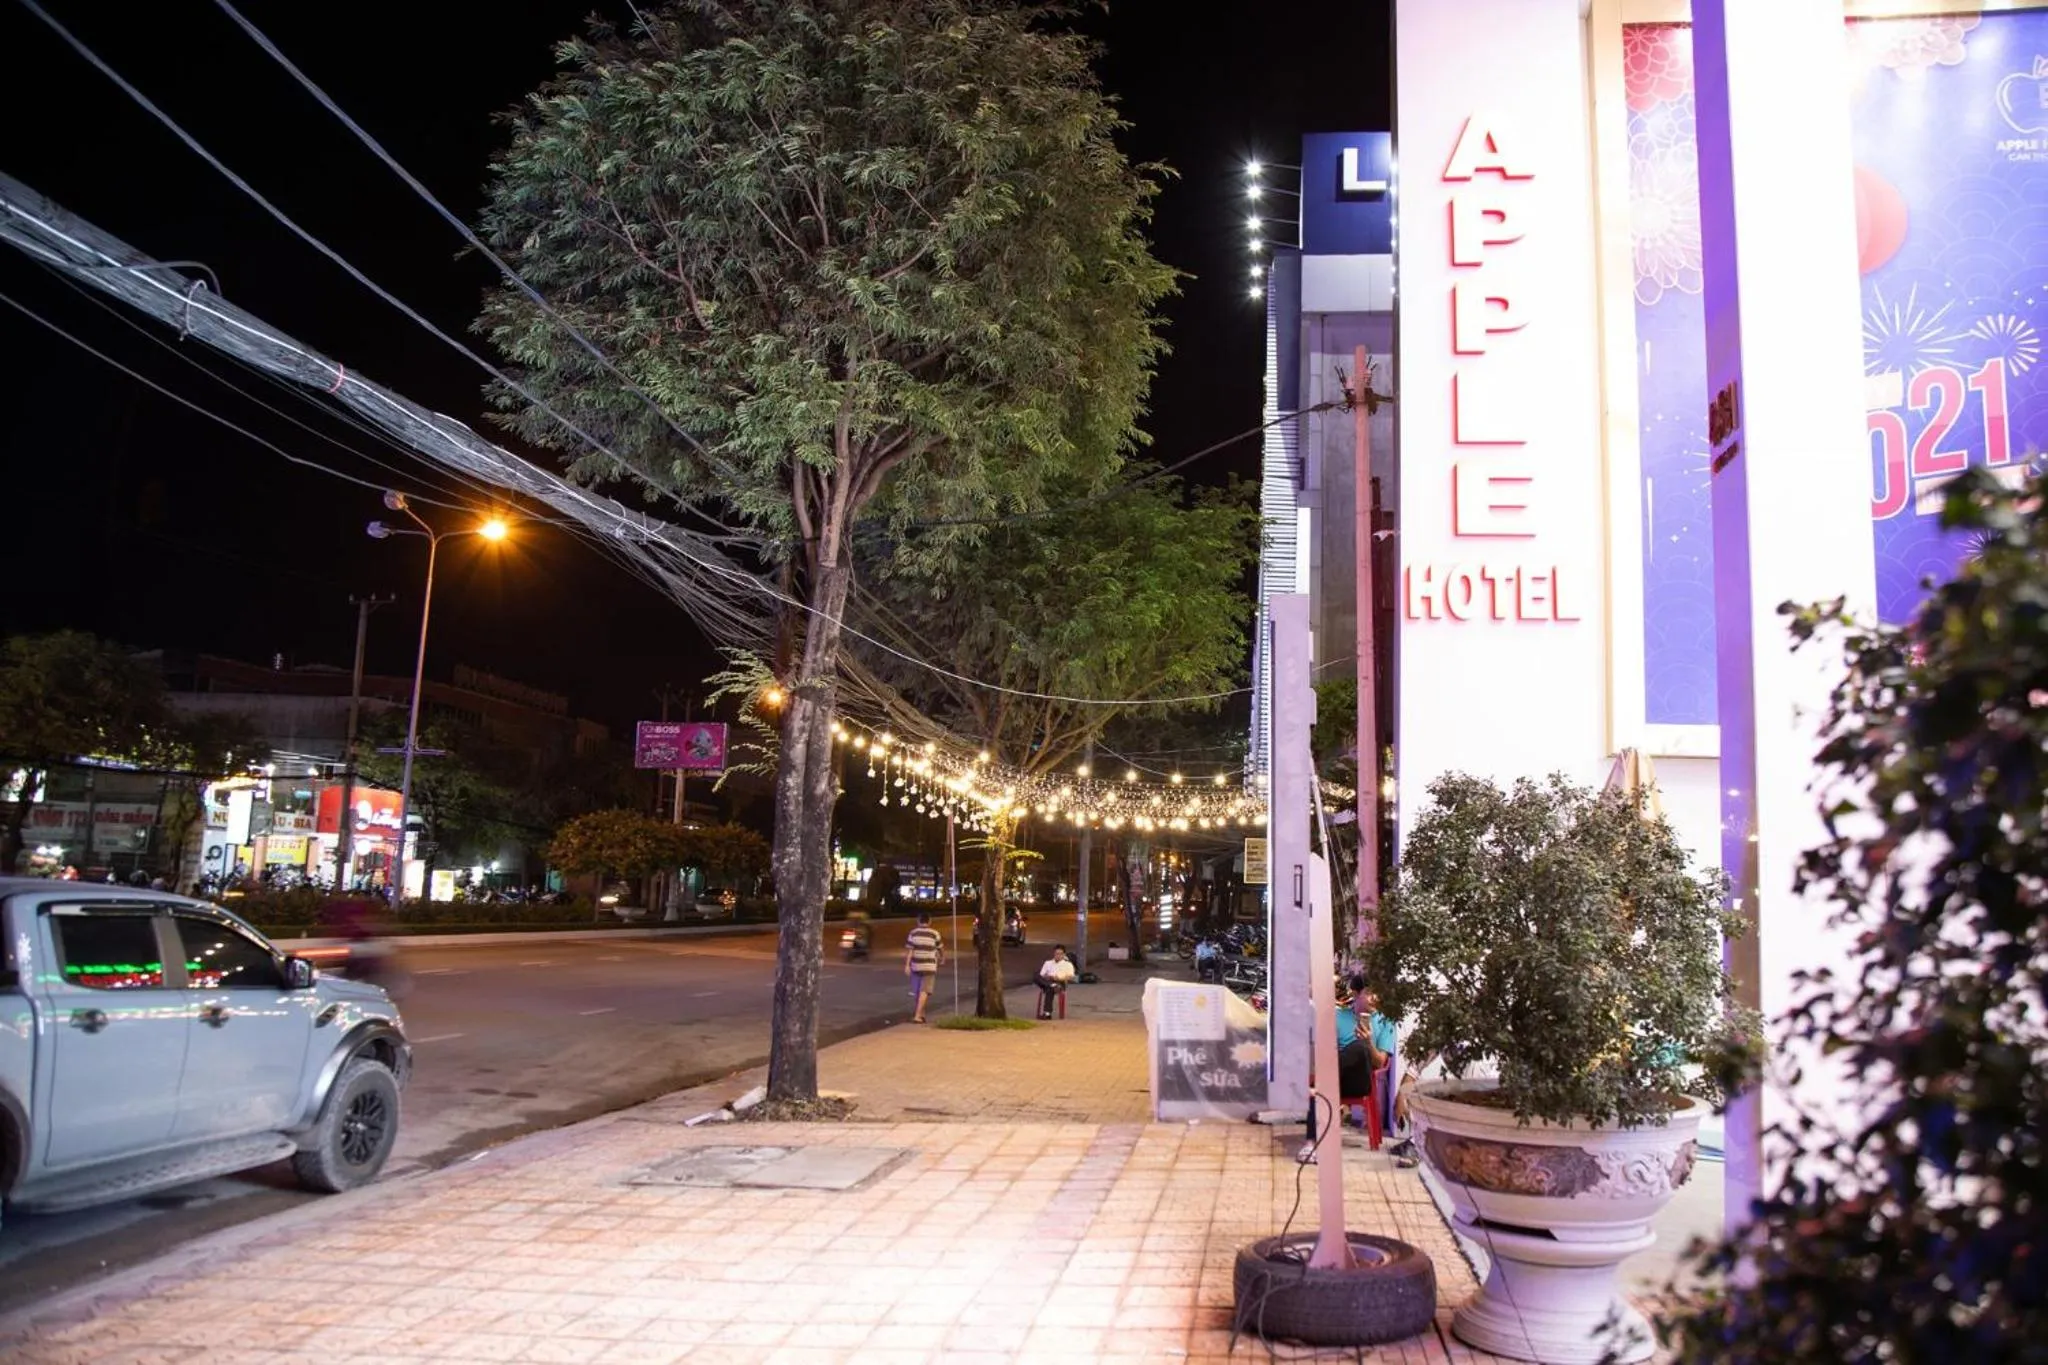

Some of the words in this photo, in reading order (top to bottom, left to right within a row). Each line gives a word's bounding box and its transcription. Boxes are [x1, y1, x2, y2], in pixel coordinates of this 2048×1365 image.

[1996, 139, 2038, 151] APPLE
[1441, 109, 1537, 538] APPLE
[1404, 564, 1581, 623] HOTEL
[1166, 1046, 1207, 1066] Phê
